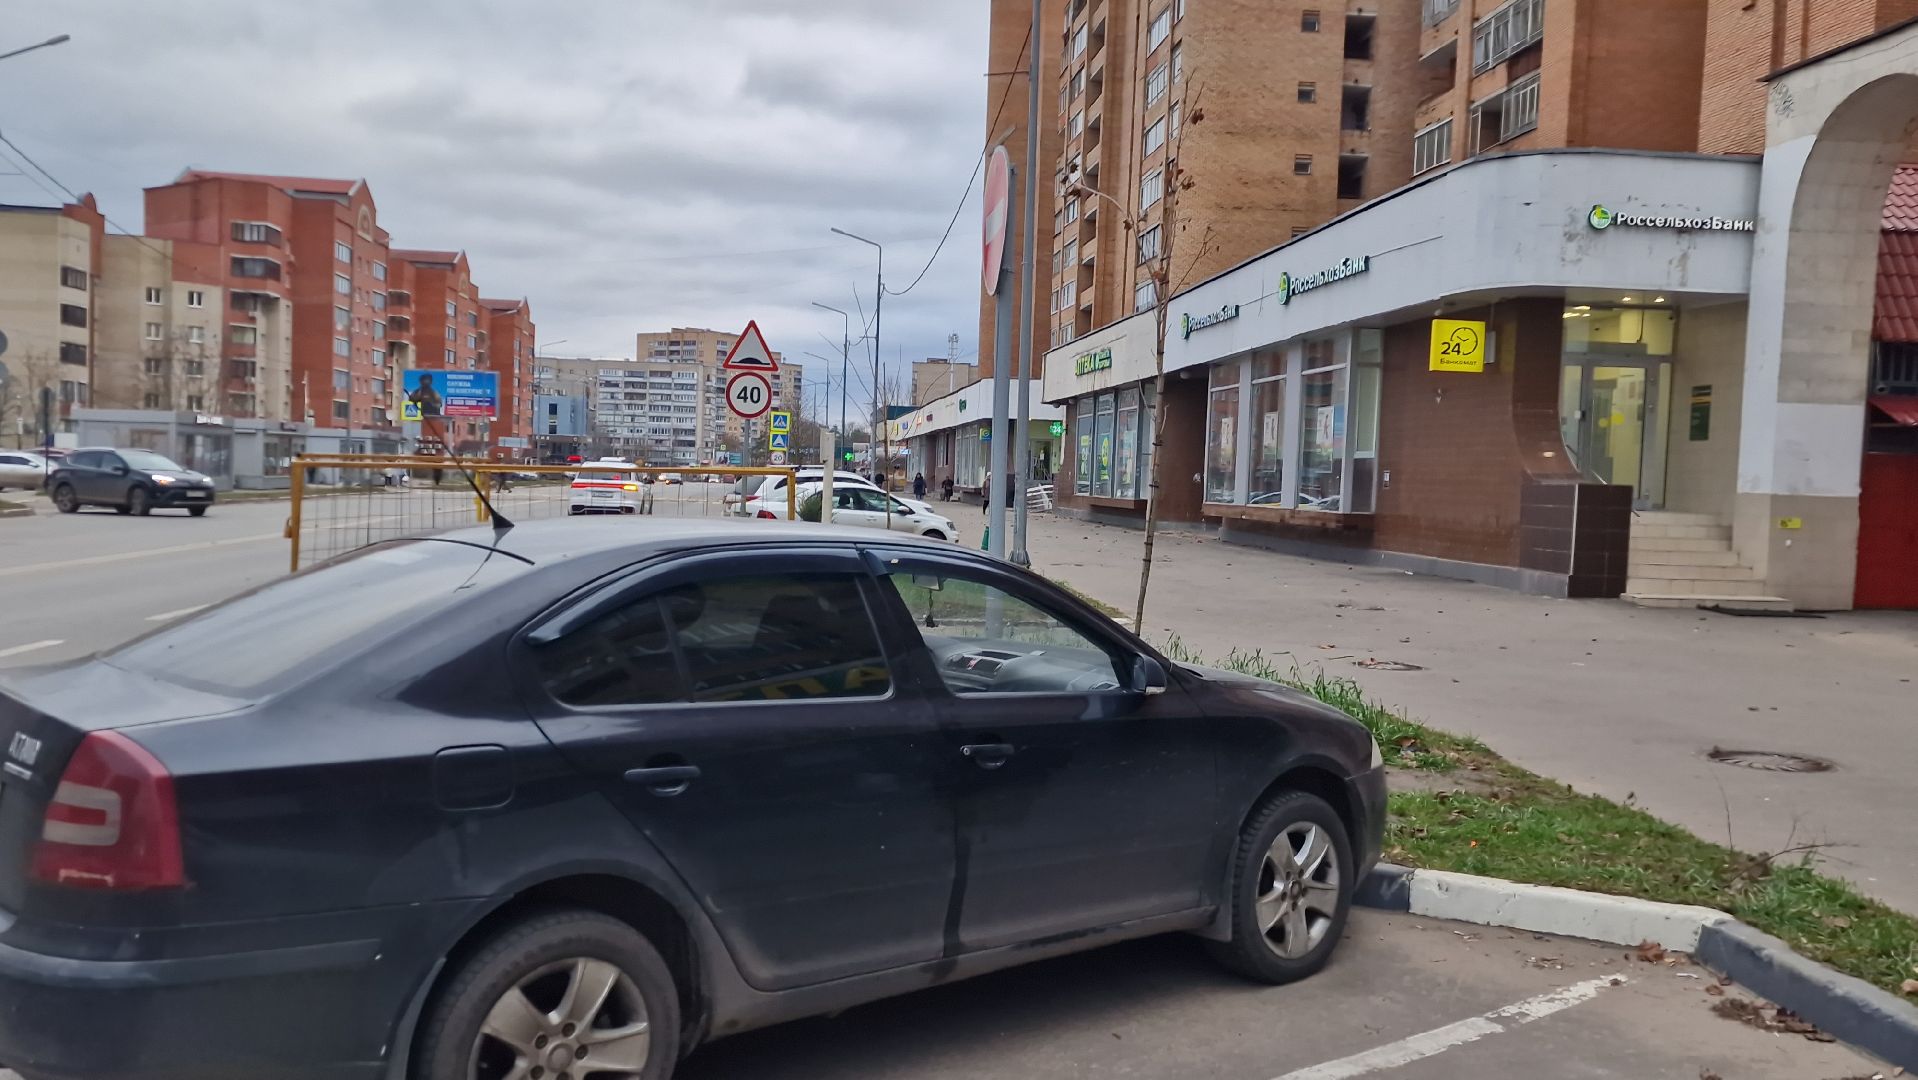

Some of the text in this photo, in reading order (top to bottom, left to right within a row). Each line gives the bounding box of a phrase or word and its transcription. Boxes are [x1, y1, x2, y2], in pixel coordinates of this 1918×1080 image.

[1616, 211, 1755, 232] РоссельхозБанк
[1289, 255, 1367, 296] РоссельхозБанк
[1441, 342, 1461, 355] 24
[1440, 358, 1478, 366] Банкомат
[736, 385, 761, 404] 40
[774, 454, 783, 462] 20
